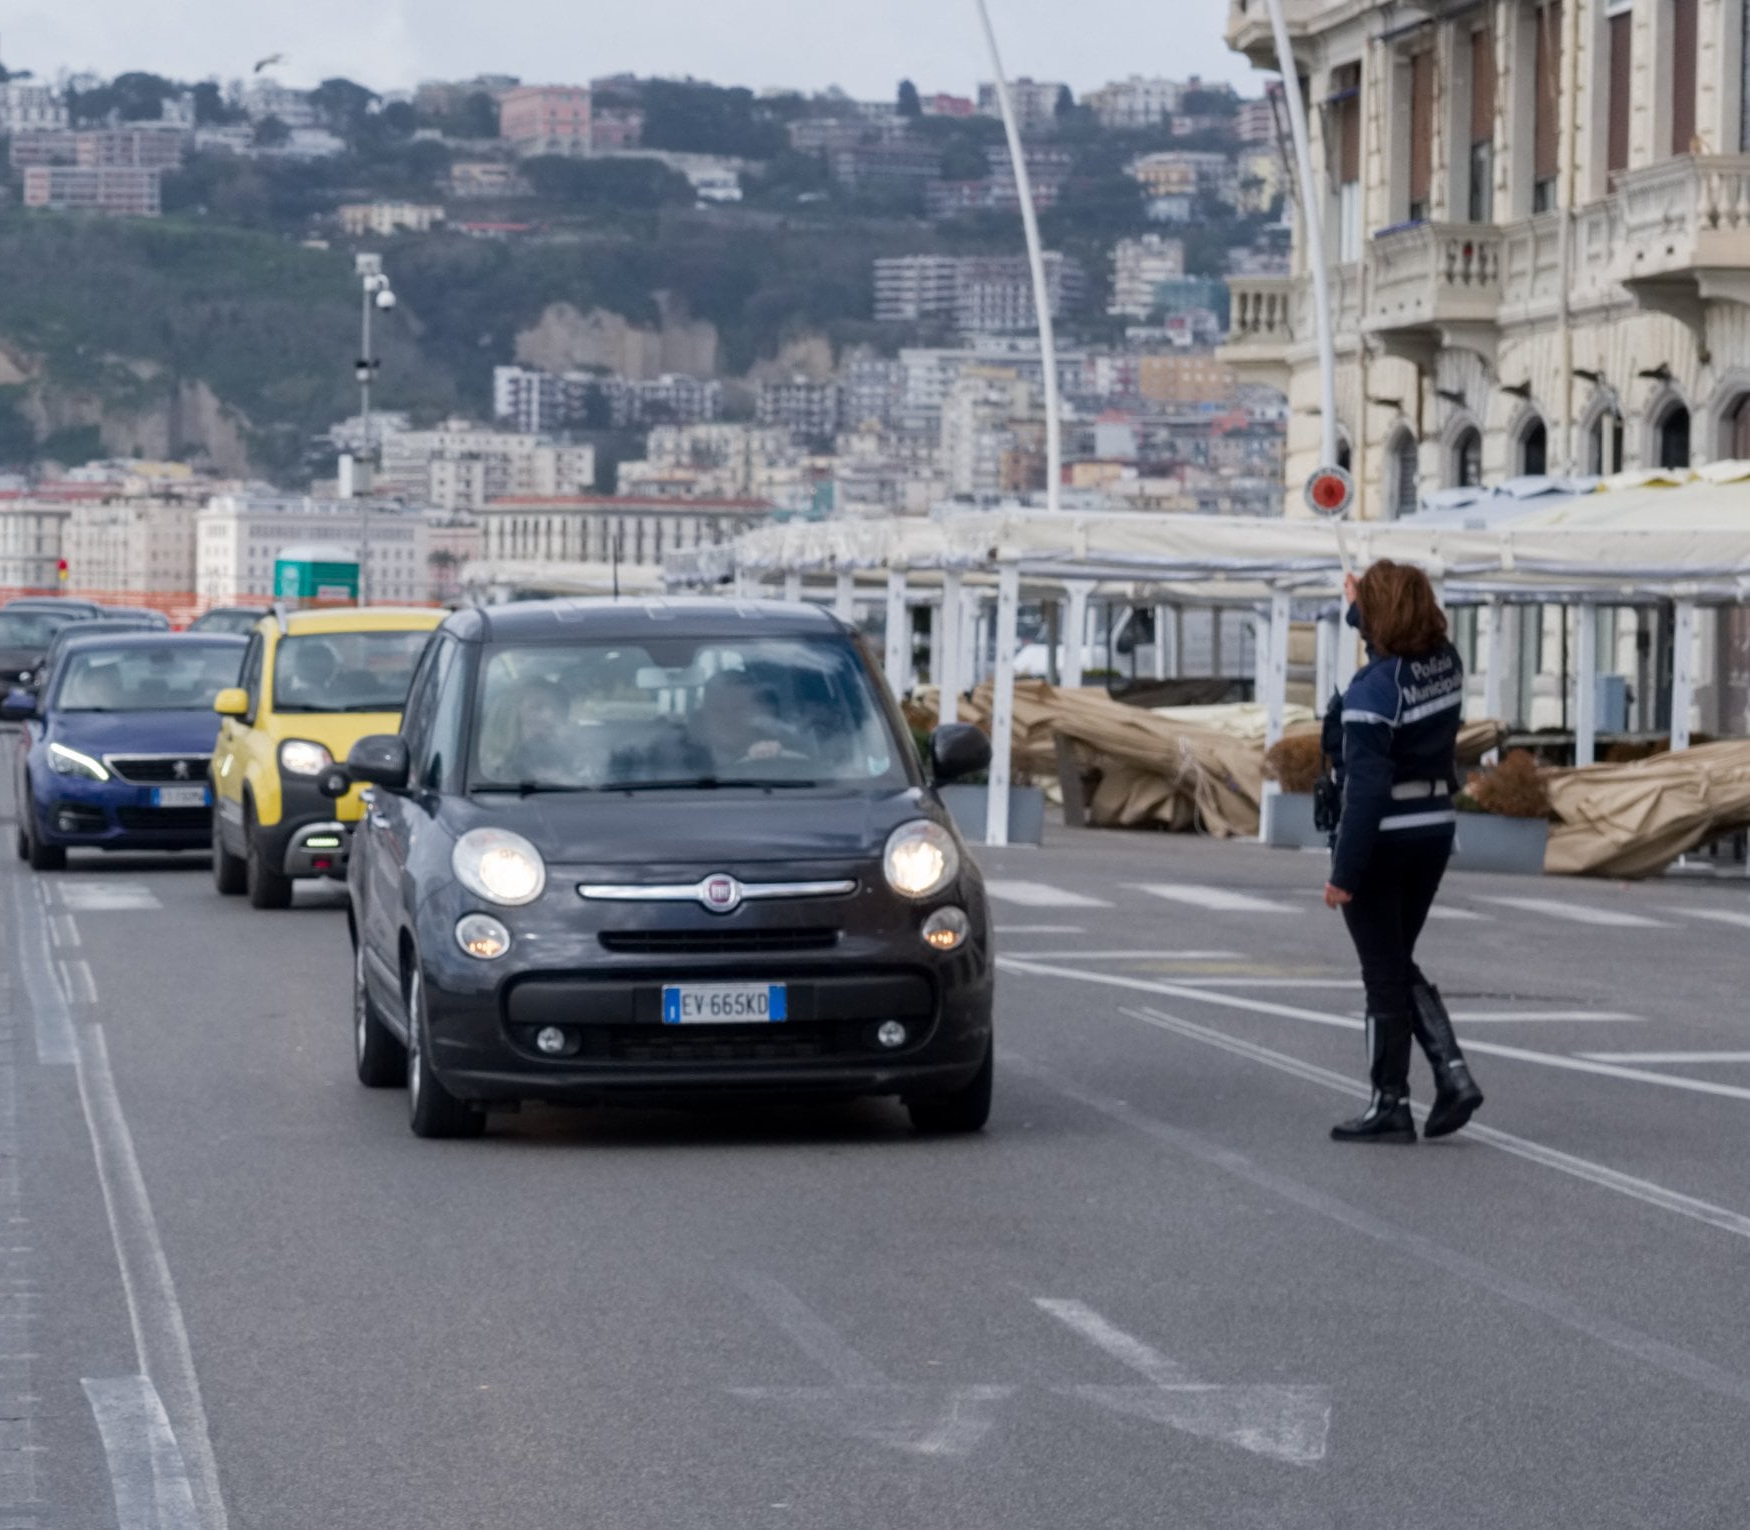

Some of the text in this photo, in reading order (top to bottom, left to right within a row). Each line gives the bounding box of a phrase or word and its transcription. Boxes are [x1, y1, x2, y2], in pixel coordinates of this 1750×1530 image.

[1410, 653, 1453, 681] Polizia
[681, 993, 768, 1016] EV 665KD
